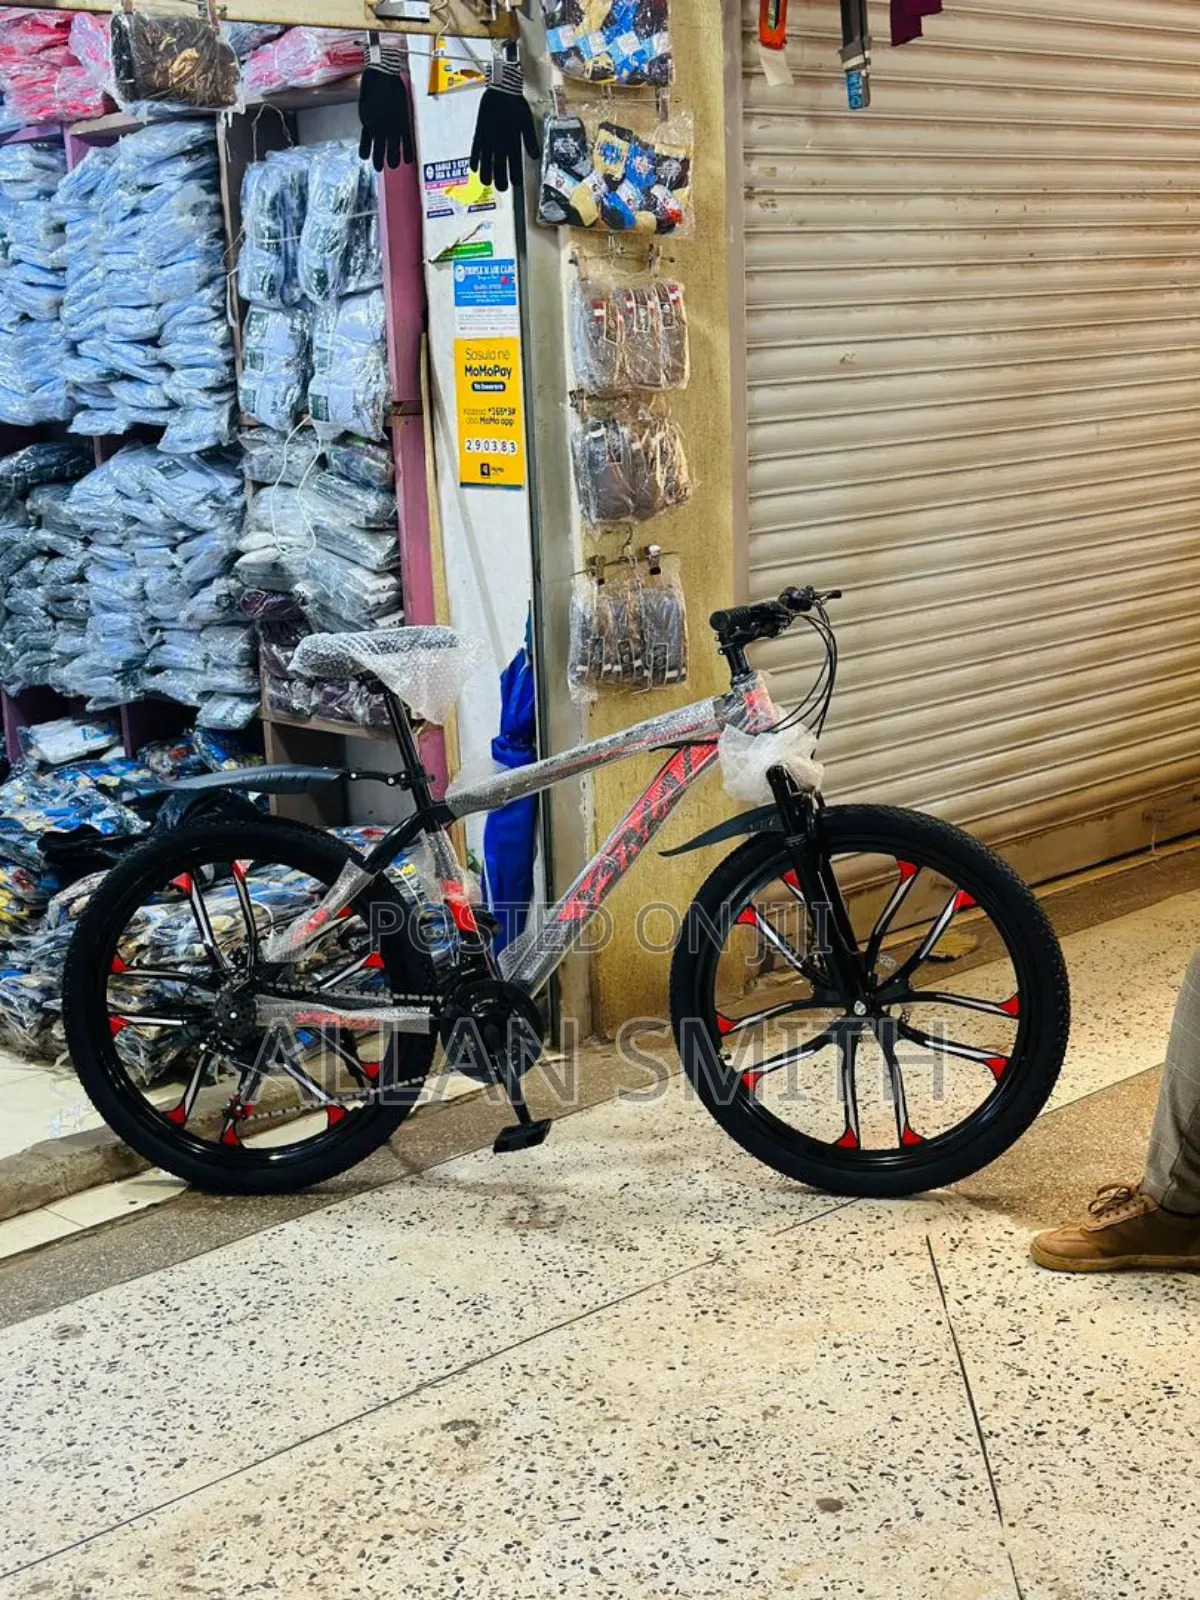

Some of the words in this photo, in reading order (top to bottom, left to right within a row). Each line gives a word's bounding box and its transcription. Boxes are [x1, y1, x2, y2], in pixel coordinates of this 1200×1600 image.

[464, 364, 512, 379] MoMoPay
[480, 416, 500, 425] MoMo
[500, 418, 514, 427] app
